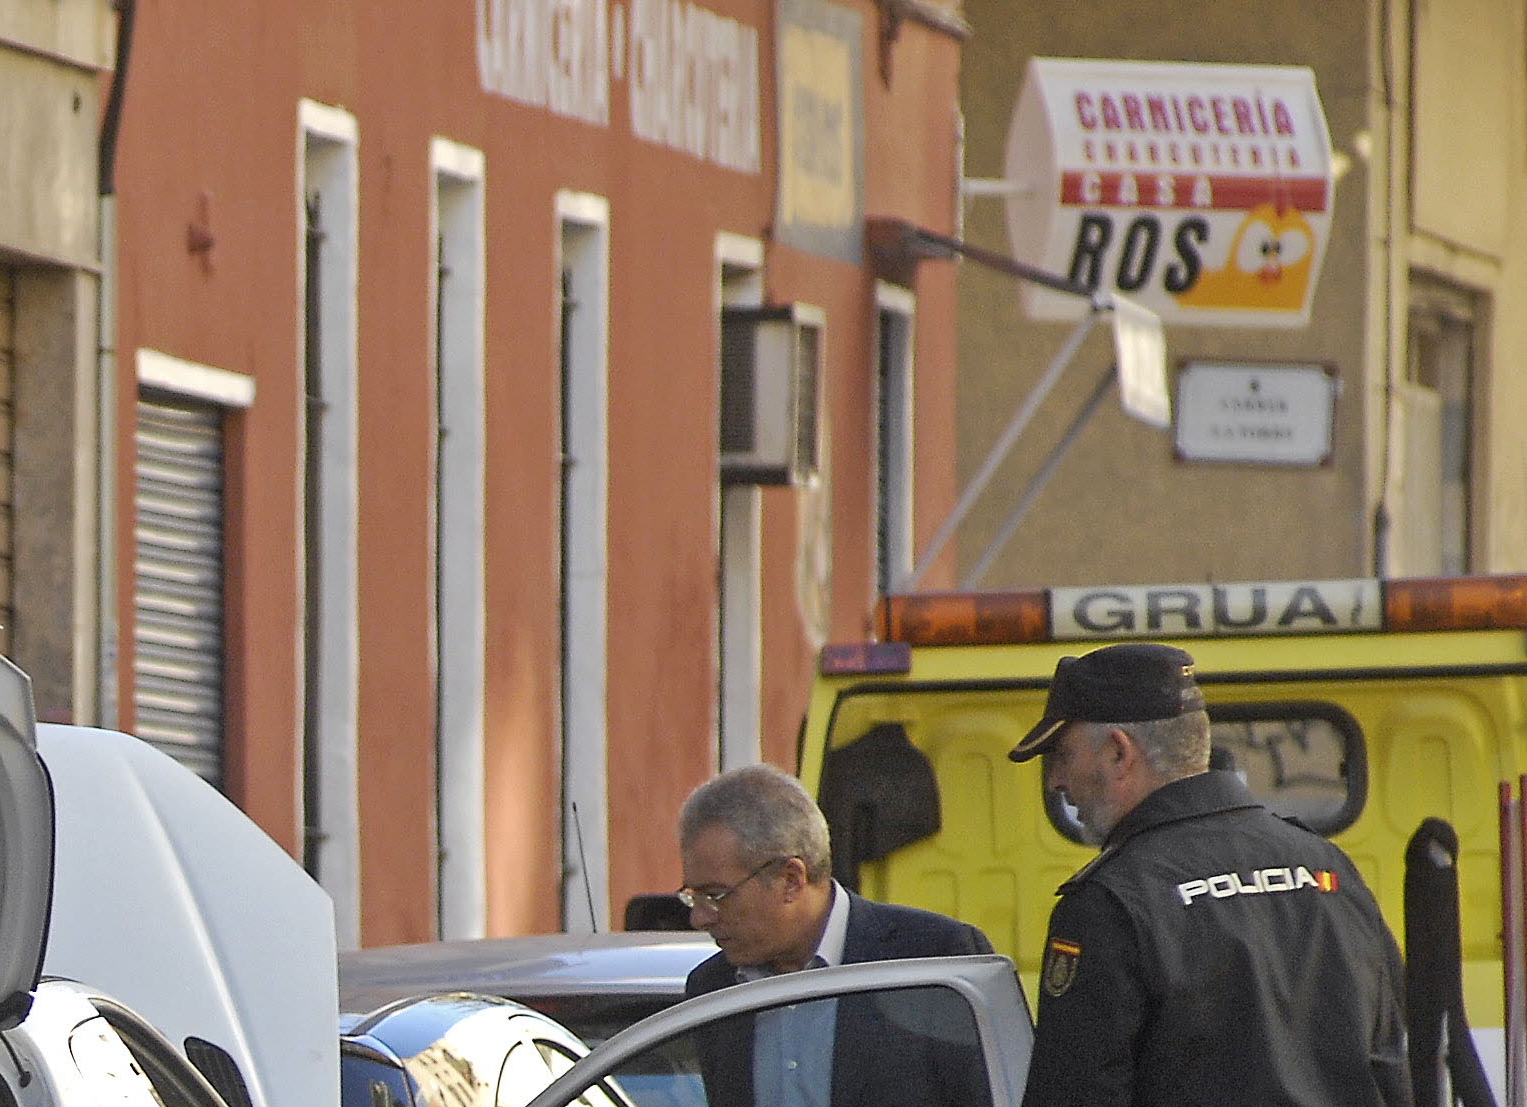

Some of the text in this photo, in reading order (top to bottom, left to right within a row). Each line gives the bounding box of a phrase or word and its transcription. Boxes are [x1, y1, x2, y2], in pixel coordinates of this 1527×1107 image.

[1067, 212, 1211, 297] ROS
[1072, 585, 1339, 633] GRUA
[1178, 865, 1320, 906] POLICIA
